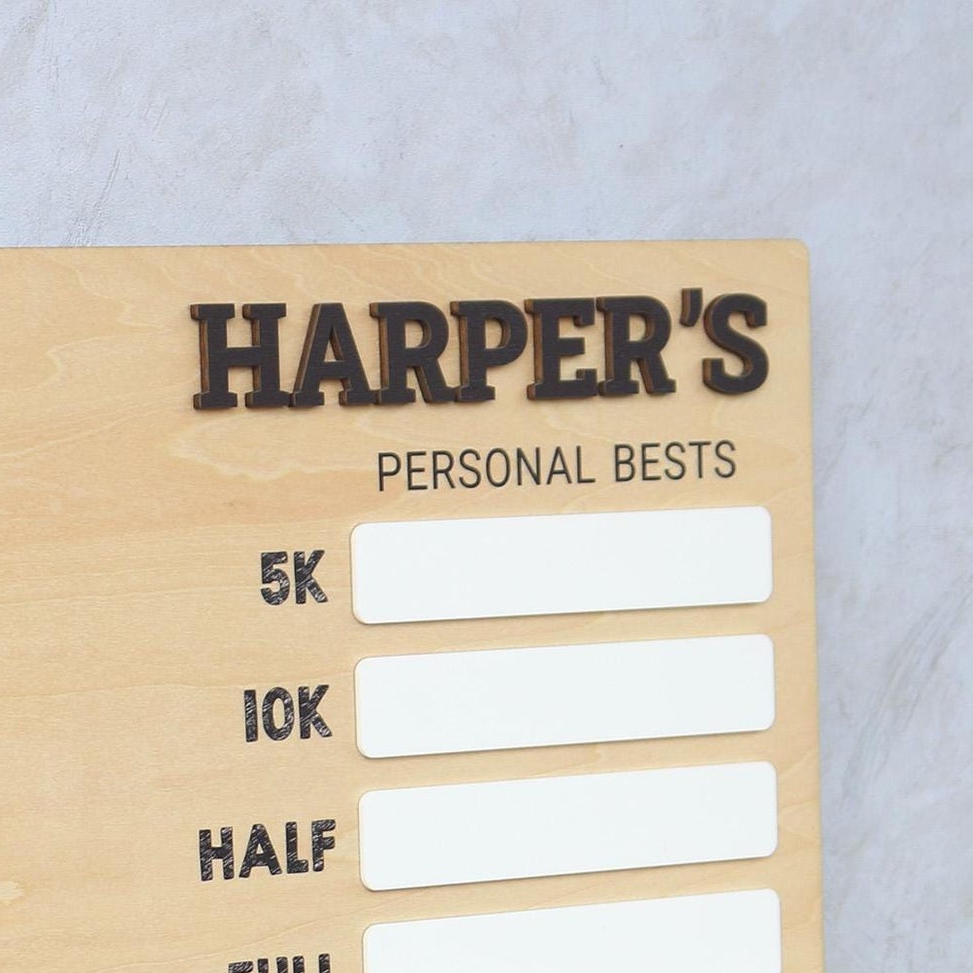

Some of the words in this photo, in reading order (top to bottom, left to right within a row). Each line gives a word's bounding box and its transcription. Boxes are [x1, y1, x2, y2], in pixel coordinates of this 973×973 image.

[189, 288, 770, 411] HARPER'S
[378, 445, 597, 492] PERSONAL
[613, 440, 738, 483] BESTS
[260, 549, 329, 606] 5K
[198, 818, 338, 882] HALF
